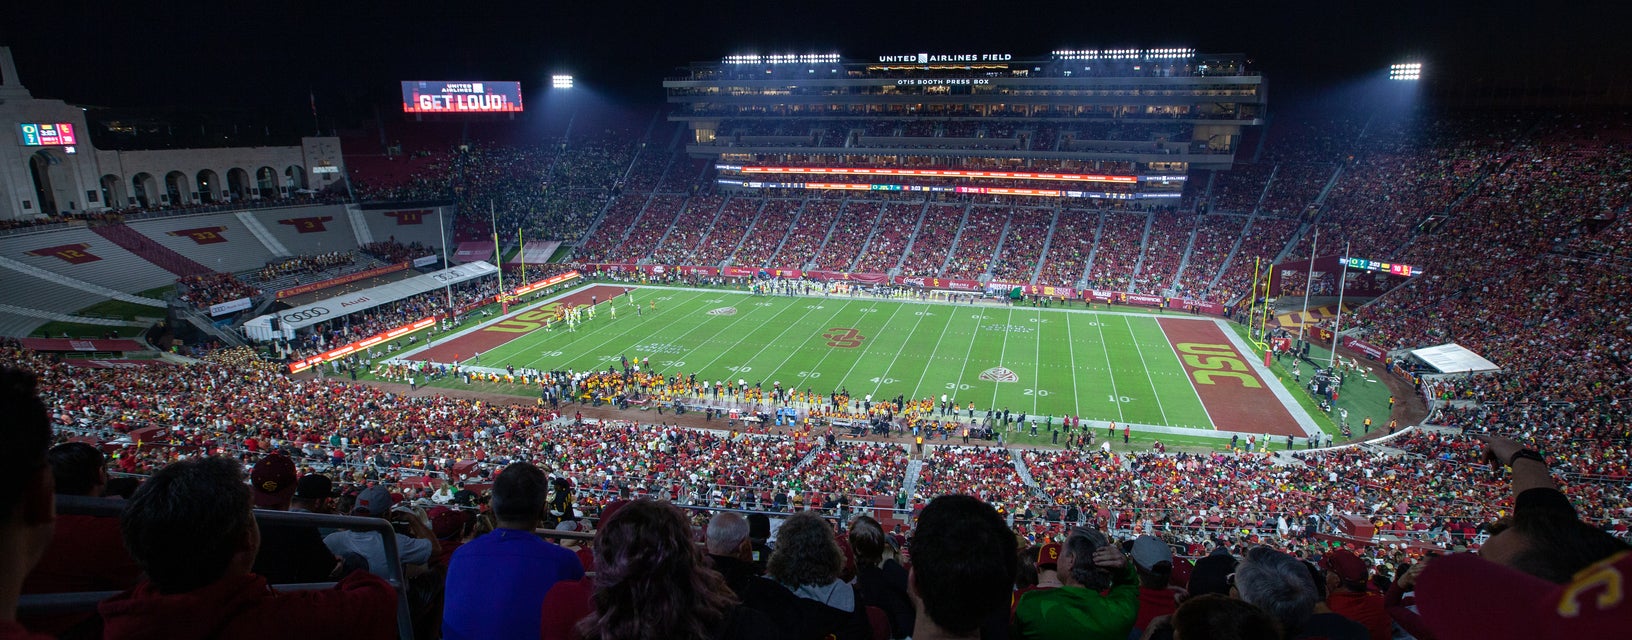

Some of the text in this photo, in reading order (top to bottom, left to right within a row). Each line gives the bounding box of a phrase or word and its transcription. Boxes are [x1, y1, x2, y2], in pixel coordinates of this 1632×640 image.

[420, 94, 453, 110] GET
[56, 250, 86, 258] 12
[341, 296, 370, 307] Audi
[483, 303, 590, 332] US
[1176, 342, 1262, 388] USC
[1024, 388, 1049, 396] 20
[1108, 394, 1131, 403] 10
[1049, 548, 1058, 560] SC
